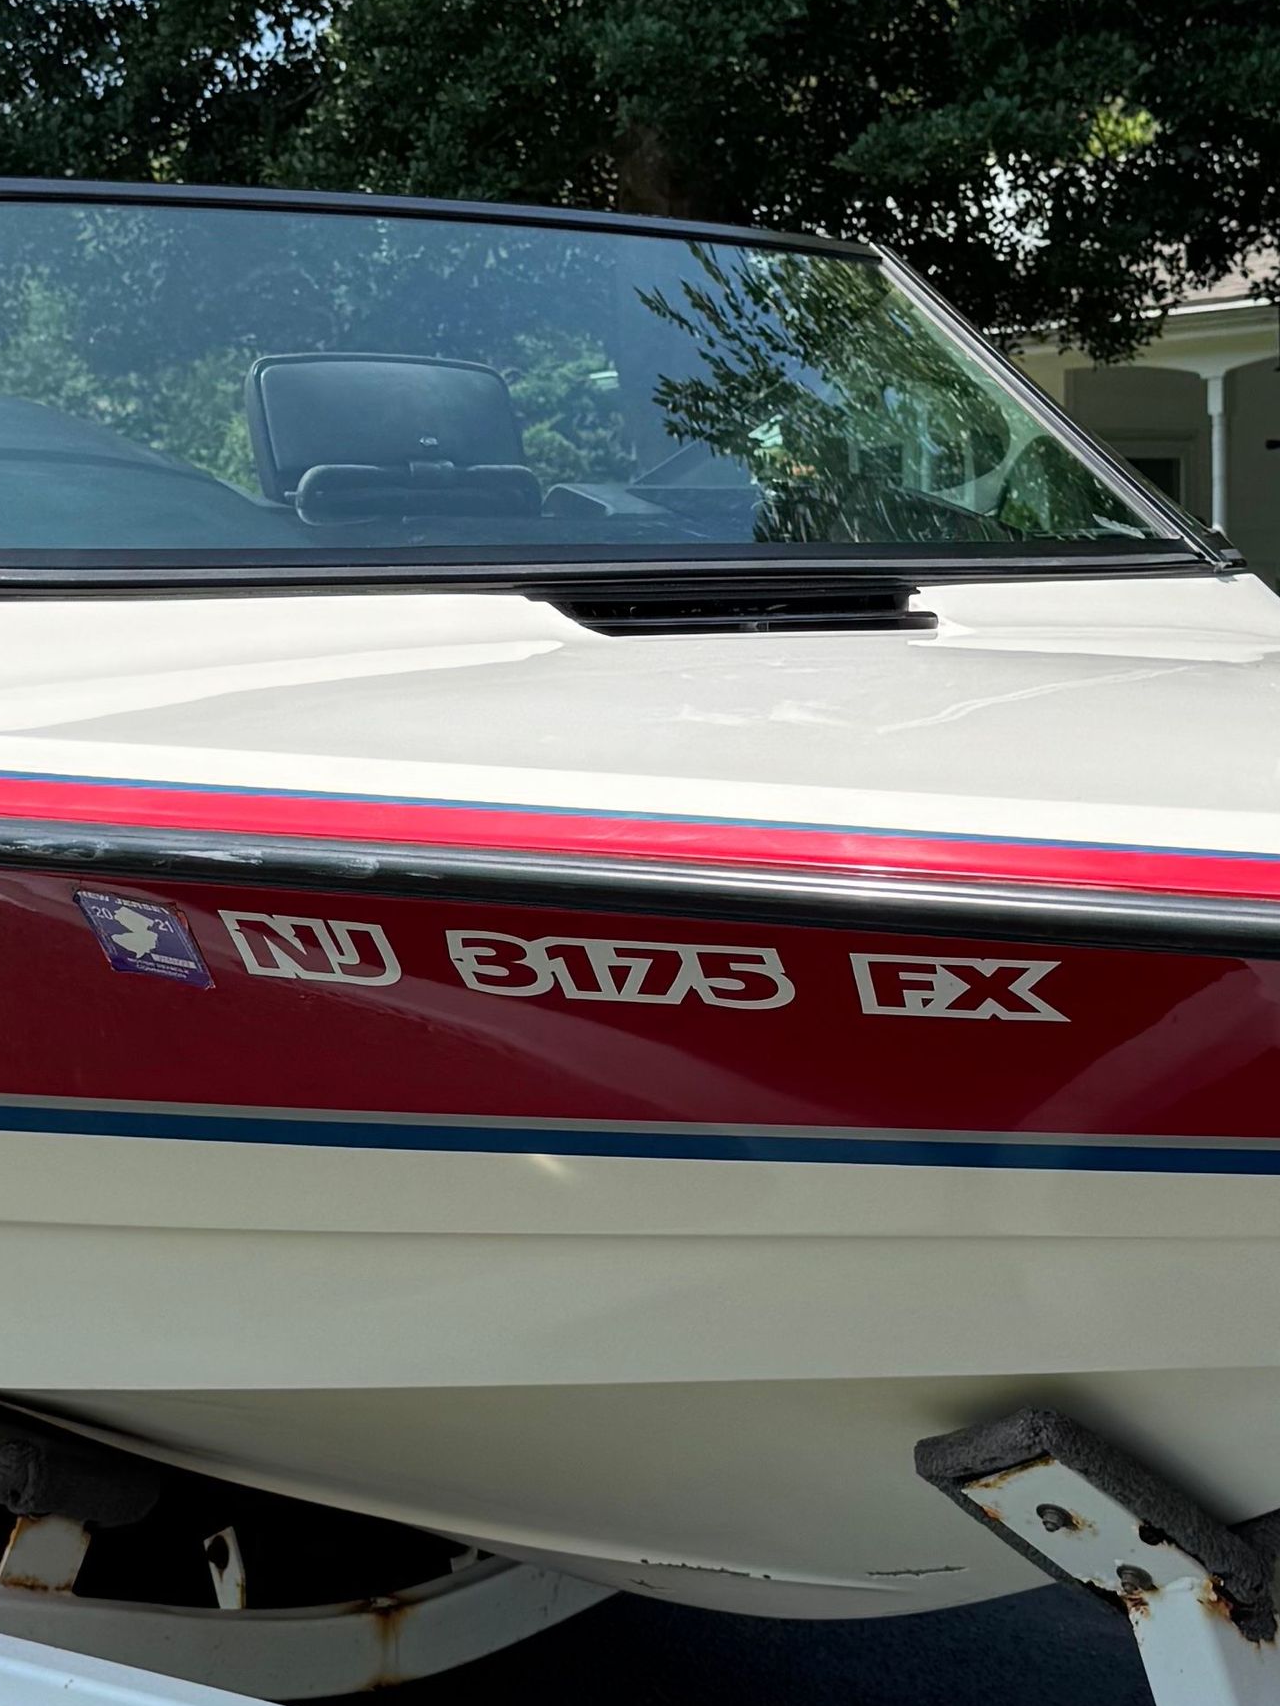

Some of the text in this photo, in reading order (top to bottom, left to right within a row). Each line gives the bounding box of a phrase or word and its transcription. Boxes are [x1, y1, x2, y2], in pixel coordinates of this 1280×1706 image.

[90, 905, 175, 934] 20 21
[218, 909, 1072, 1022] NJ 3175 FX
